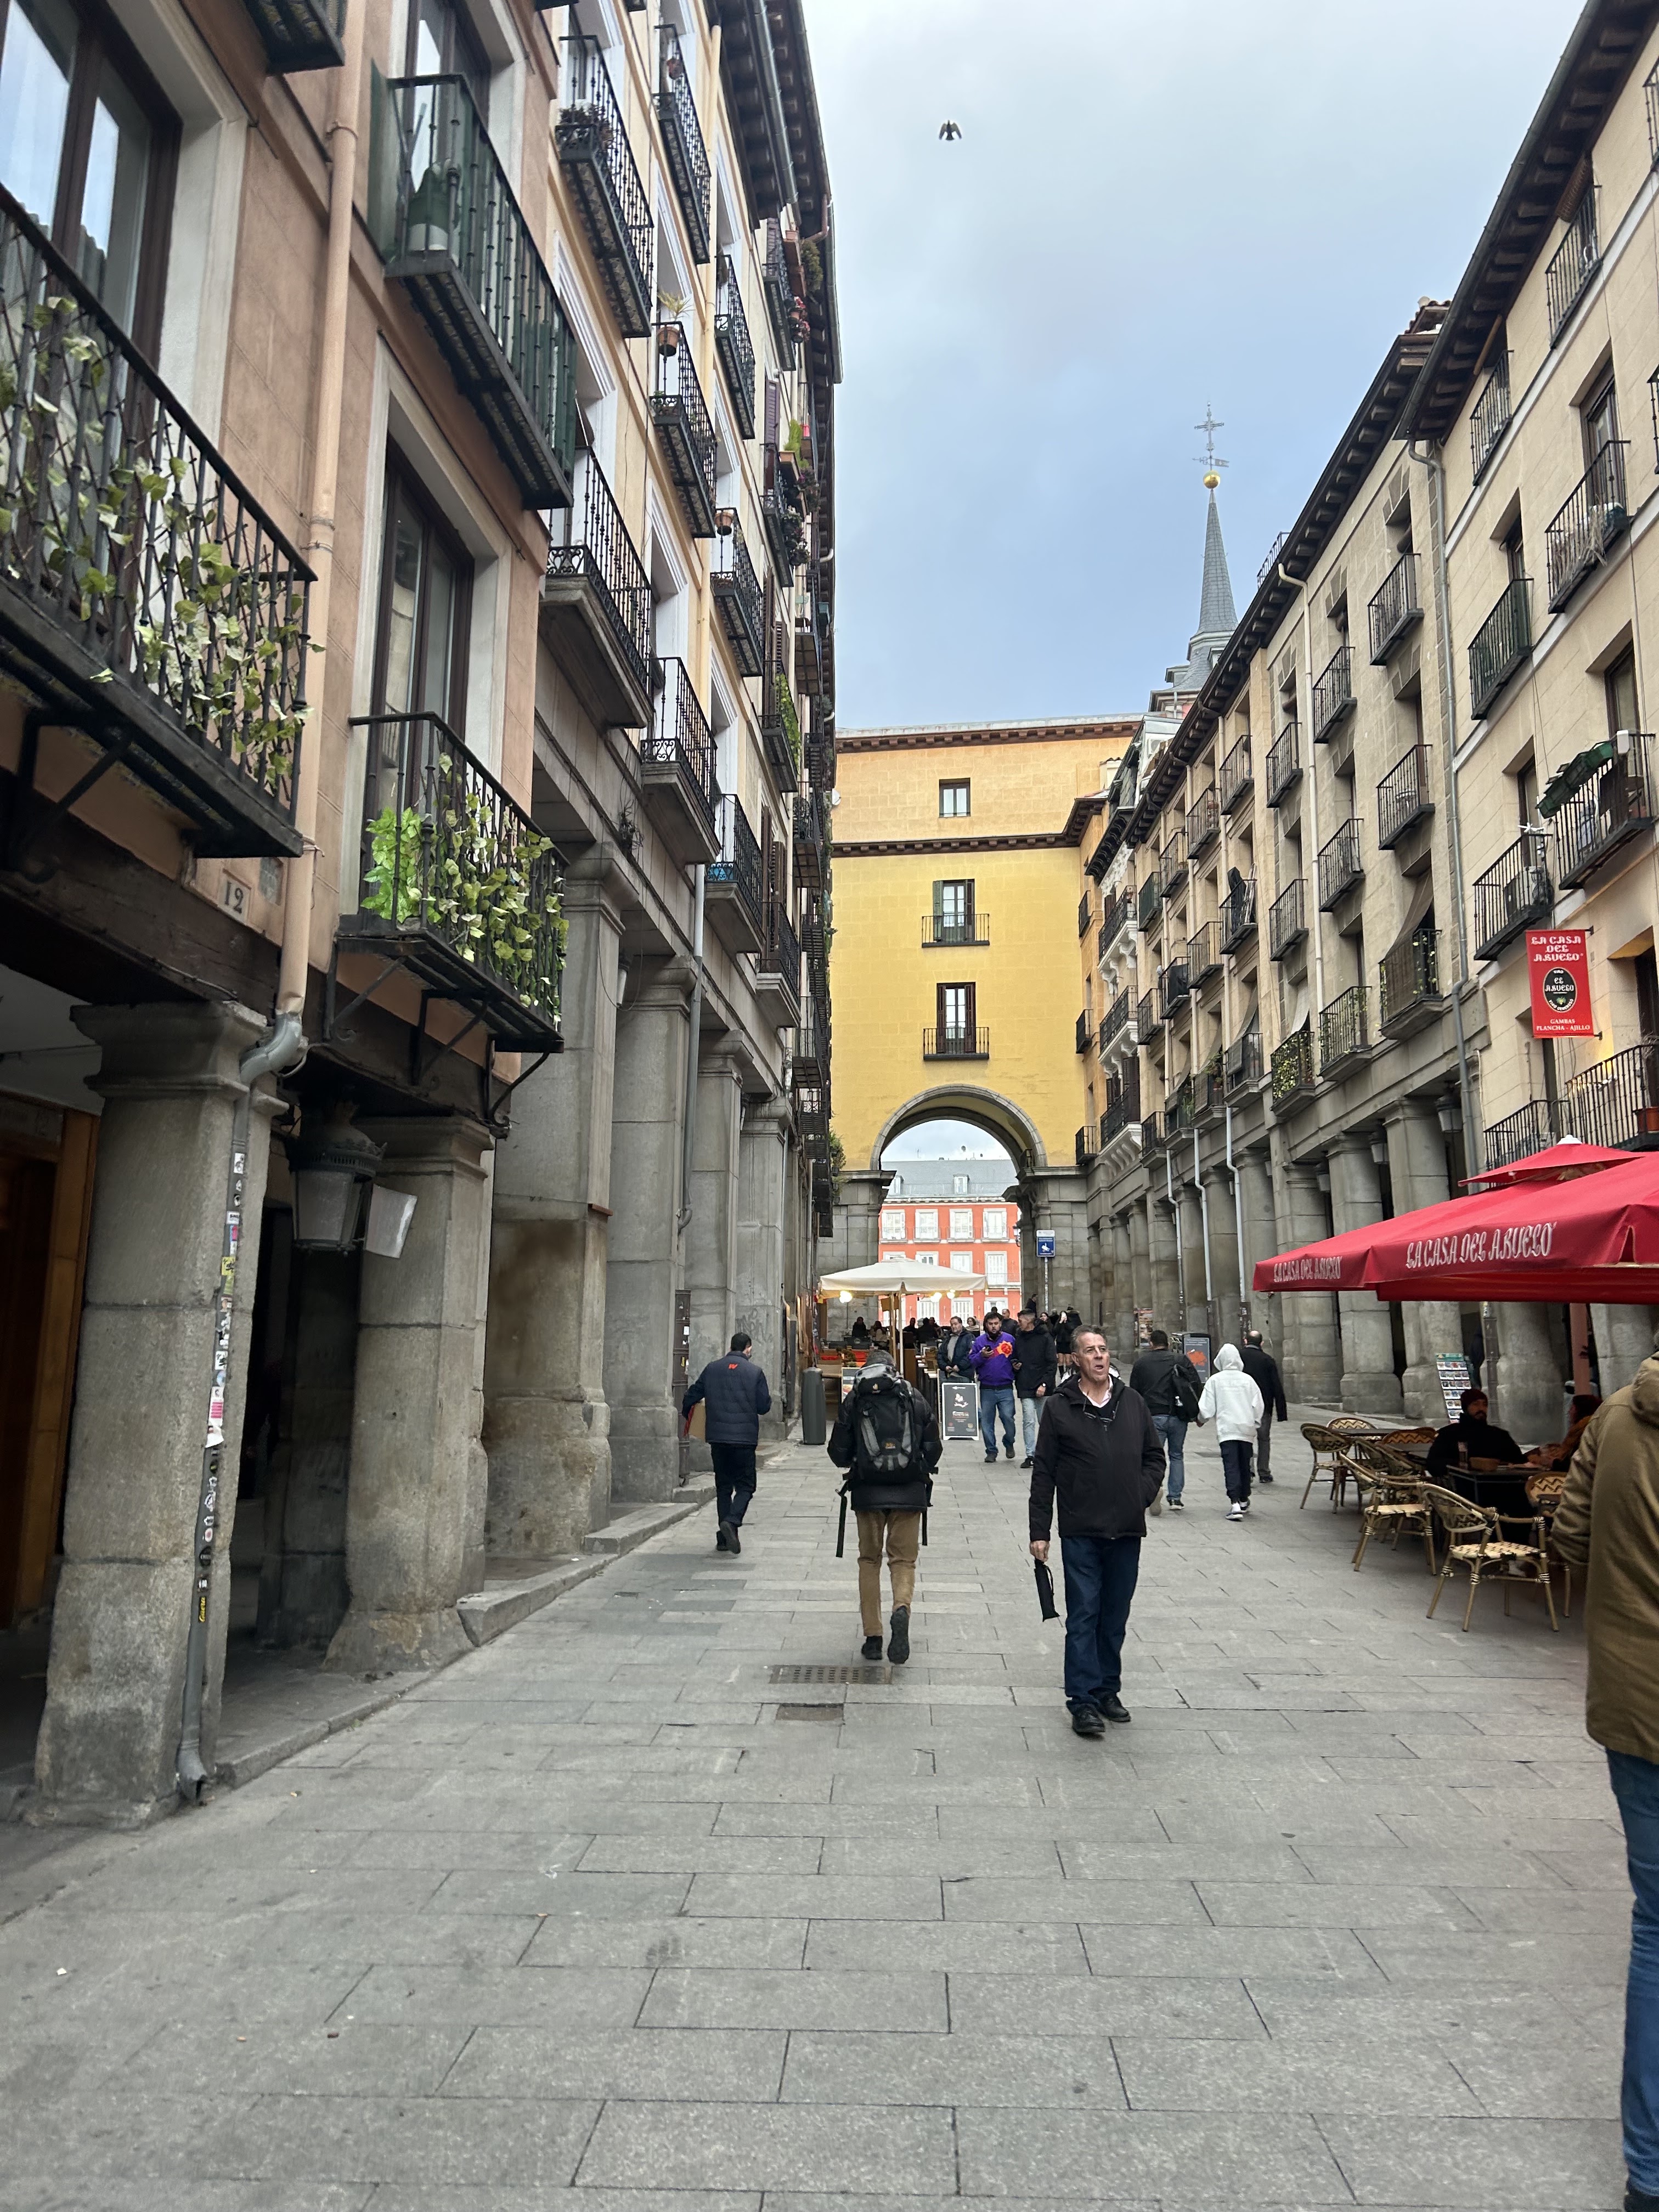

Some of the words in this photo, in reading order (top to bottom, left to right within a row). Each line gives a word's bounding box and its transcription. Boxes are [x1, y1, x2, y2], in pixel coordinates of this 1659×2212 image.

[224, 881, 244, 914] 12
[1531, 936, 1547, 945] LA
[1549, 935, 1582, 944] CASA
[1545, 945, 1569, 953] DEL
[1406, 1242, 1423, 1269] LA
[1423, 1235, 1458, 1267] CASA
[1459, 1231, 1487, 1263] DEL
[1488, 1222, 1553, 1261] ABUELO
[1274, 1263, 1283, 1283] LA
[1283, 1260, 1300, 1282] CASA
[1301, 1258, 1313, 1280] DEL
